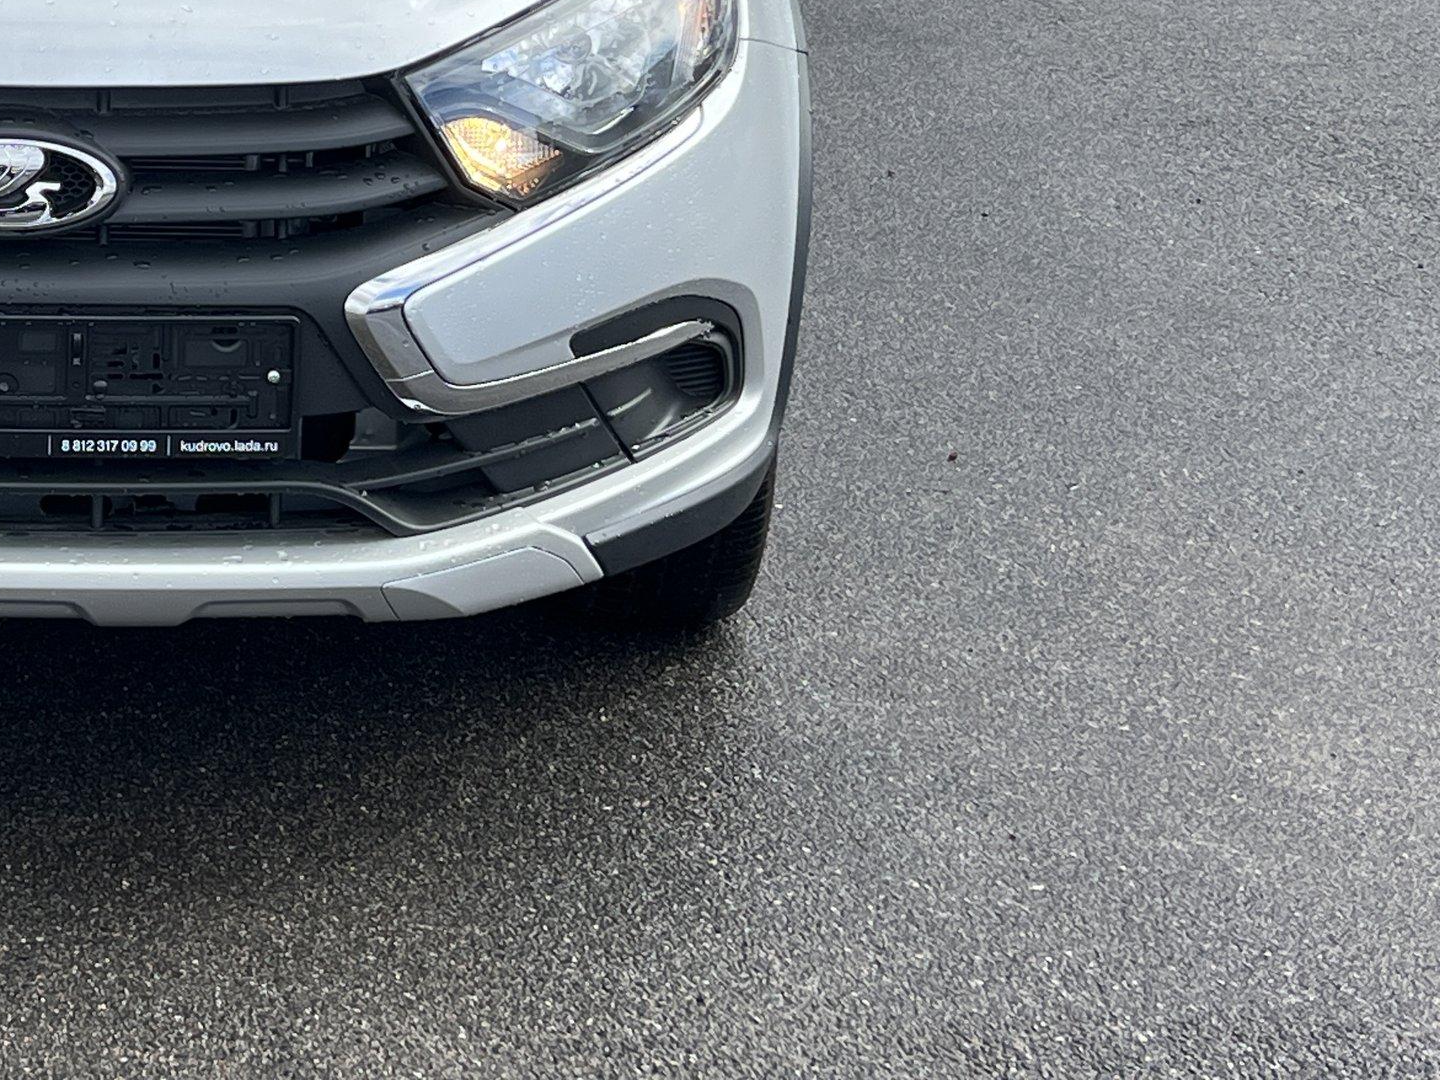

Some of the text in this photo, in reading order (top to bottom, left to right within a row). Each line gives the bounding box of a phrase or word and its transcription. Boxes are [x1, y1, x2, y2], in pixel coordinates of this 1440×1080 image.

[61, 439, 158, 452] 8 812 317 09 99
[180, 439, 279, 452] kudrovo.lada.ru
